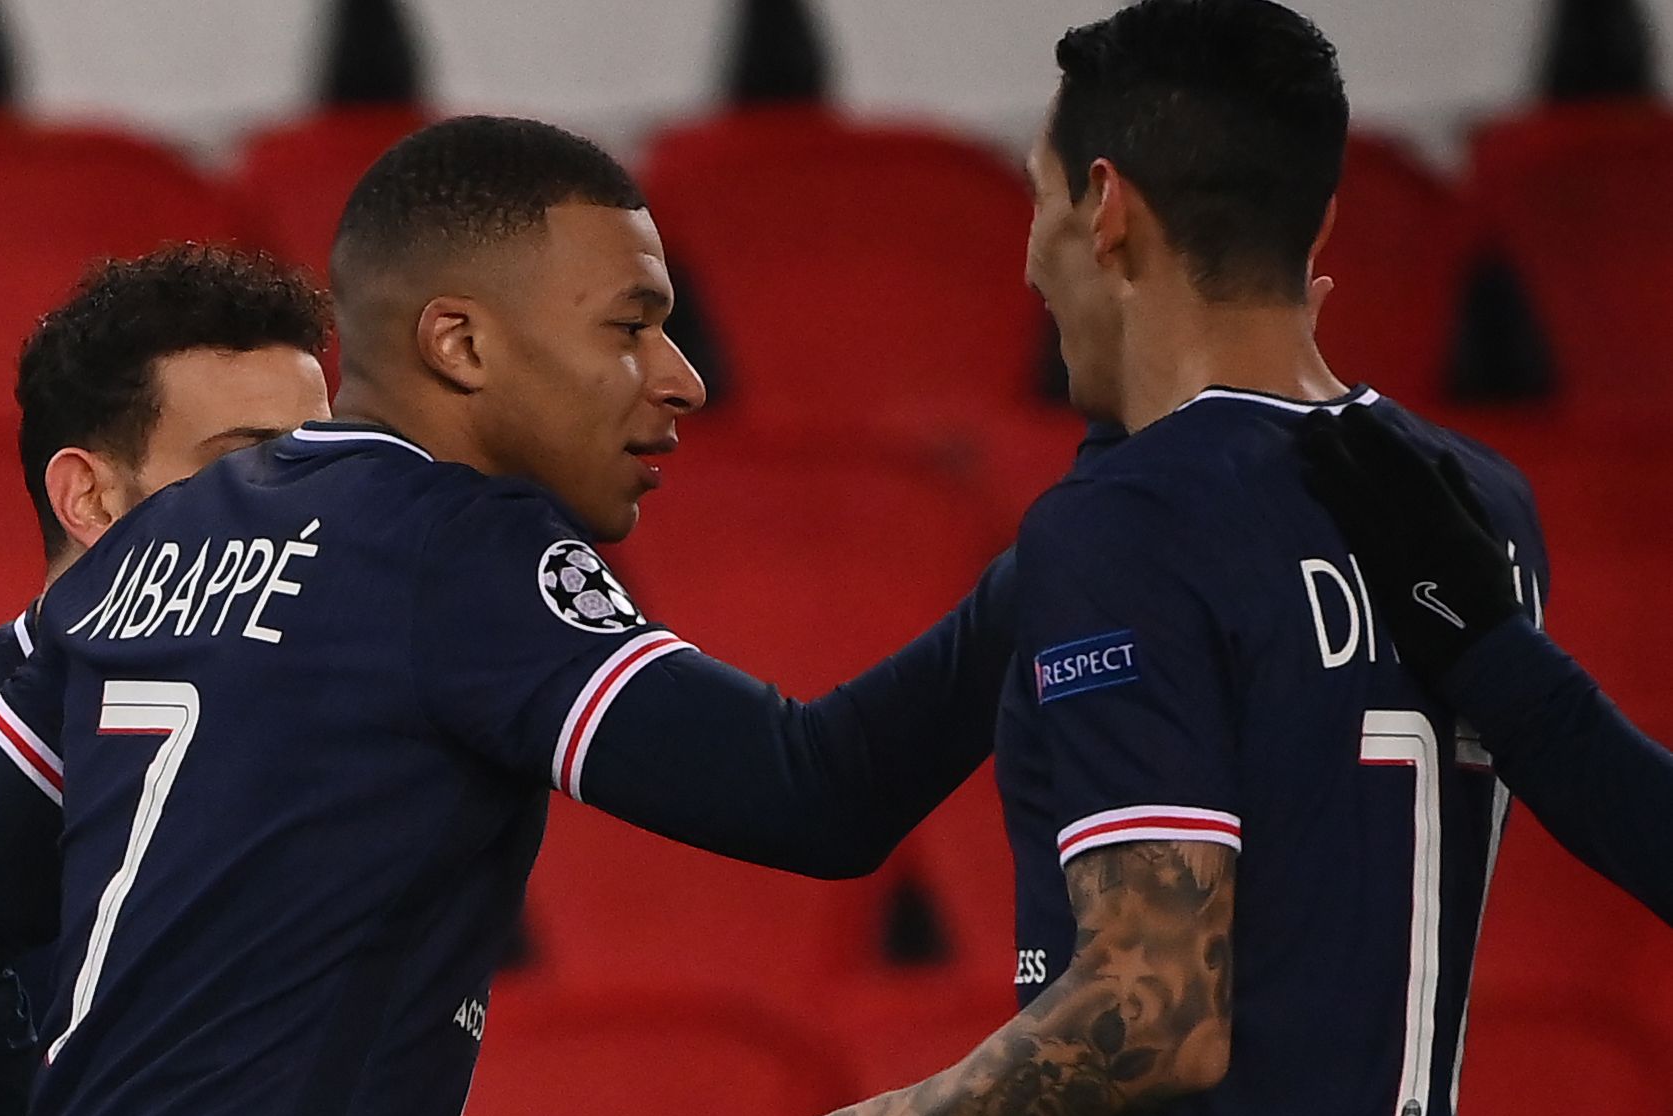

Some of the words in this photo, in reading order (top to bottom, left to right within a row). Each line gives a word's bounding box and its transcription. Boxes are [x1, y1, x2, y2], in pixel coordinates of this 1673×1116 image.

[66, 517, 321, 644] MBAPPÉ
[1300, 553, 1376, 669] DI
[1042, 643, 1134, 688] RESPECT
[44, 680, 200, 1067] 7
